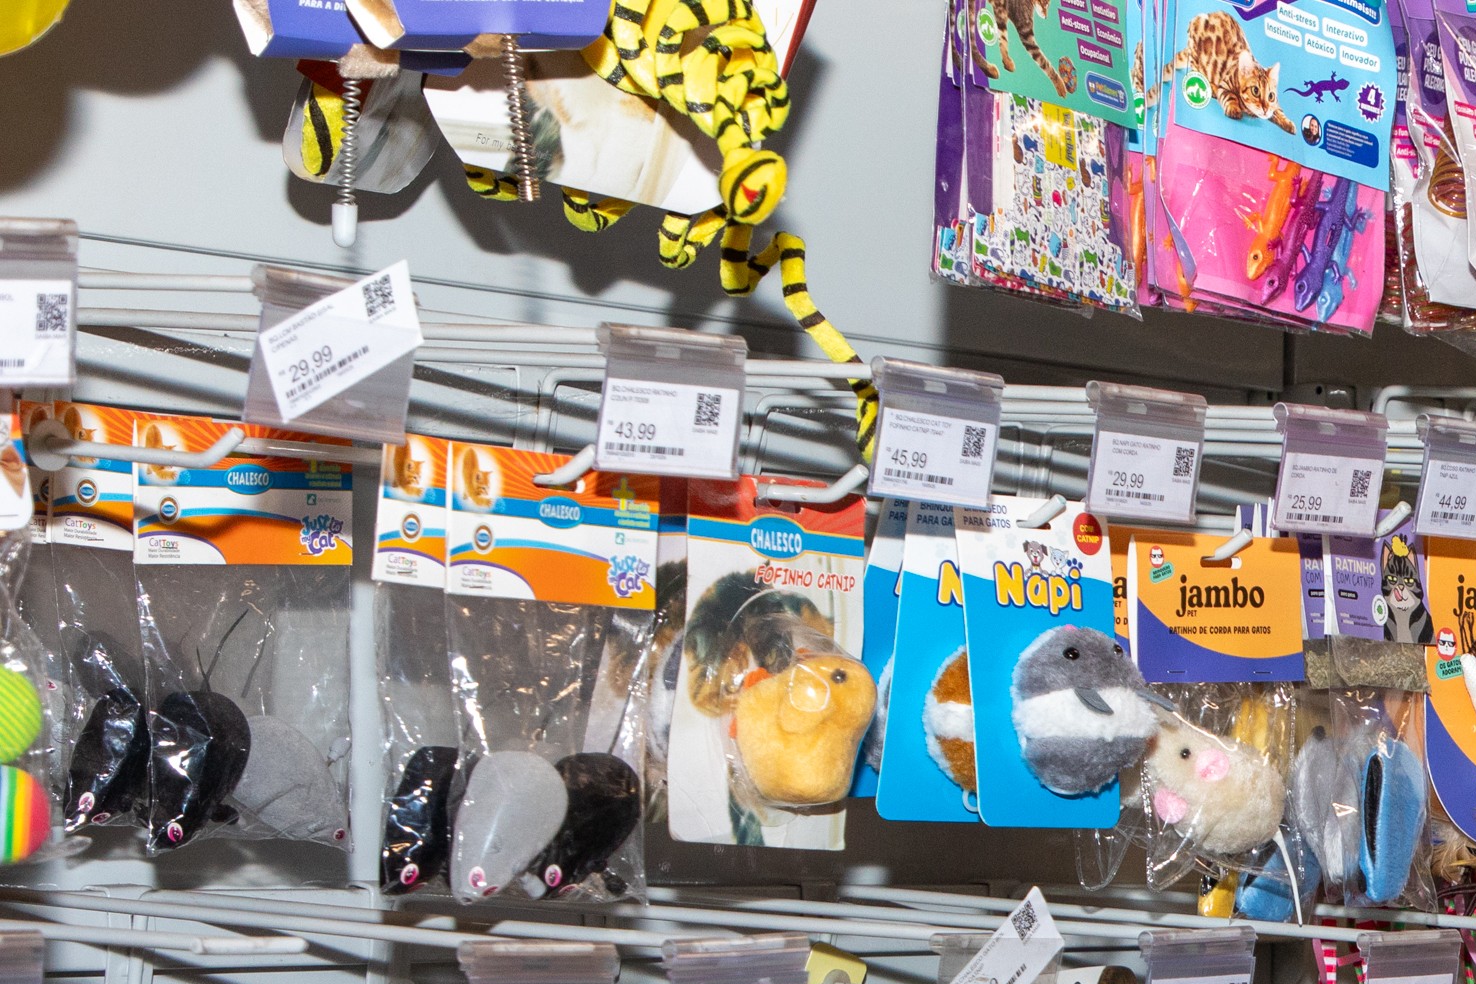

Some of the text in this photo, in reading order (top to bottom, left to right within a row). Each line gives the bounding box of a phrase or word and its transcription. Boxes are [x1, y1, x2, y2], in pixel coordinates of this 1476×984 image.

[1279, 6, 1317, 28] Anti-stress
[1266, 22, 1300, 42] Instintivo
[1326, 24, 1365, 43] Interativo
[1306, 38, 1335, 55] Atóxico
[1342, 50, 1377, 68] Inovador
[1366, 88, 1377, 106] 4
[289, 344, 334, 384] 29,99
[614, 421, 657, 441] 43,99
[891, 448, 928, 469] 45,99
[227, 472, 270, 486] CHALESCO
[1112, 471, 1145, 490] 29,99
[540, 503, 581, 521] CHALESCO
[1291, 495, 1322, 511] 25,99
[1438, 495, 1467, 511] 44,99
[963, 516, 1011, 529] PARA GATOS
[149, 537, 180, 550] CatToys
[751, 527, 802, 555] CHALESCO
[1076, 534, 1100, 545] CATNIP
[1335, 557, 1376, 577] RATINHO
[754, 564, 856, 593] FOFINHO CATNIP
[1336, 572, 1375, 588] COM CATNIP
[993, 560, 1084, 616] Napi
[1176, 574, 1266, 618] jambo
[1187, 609, 1198, 618] PET
[1169, 625, 1272, 636] RATINHO DE CORDA PARA GATOS
